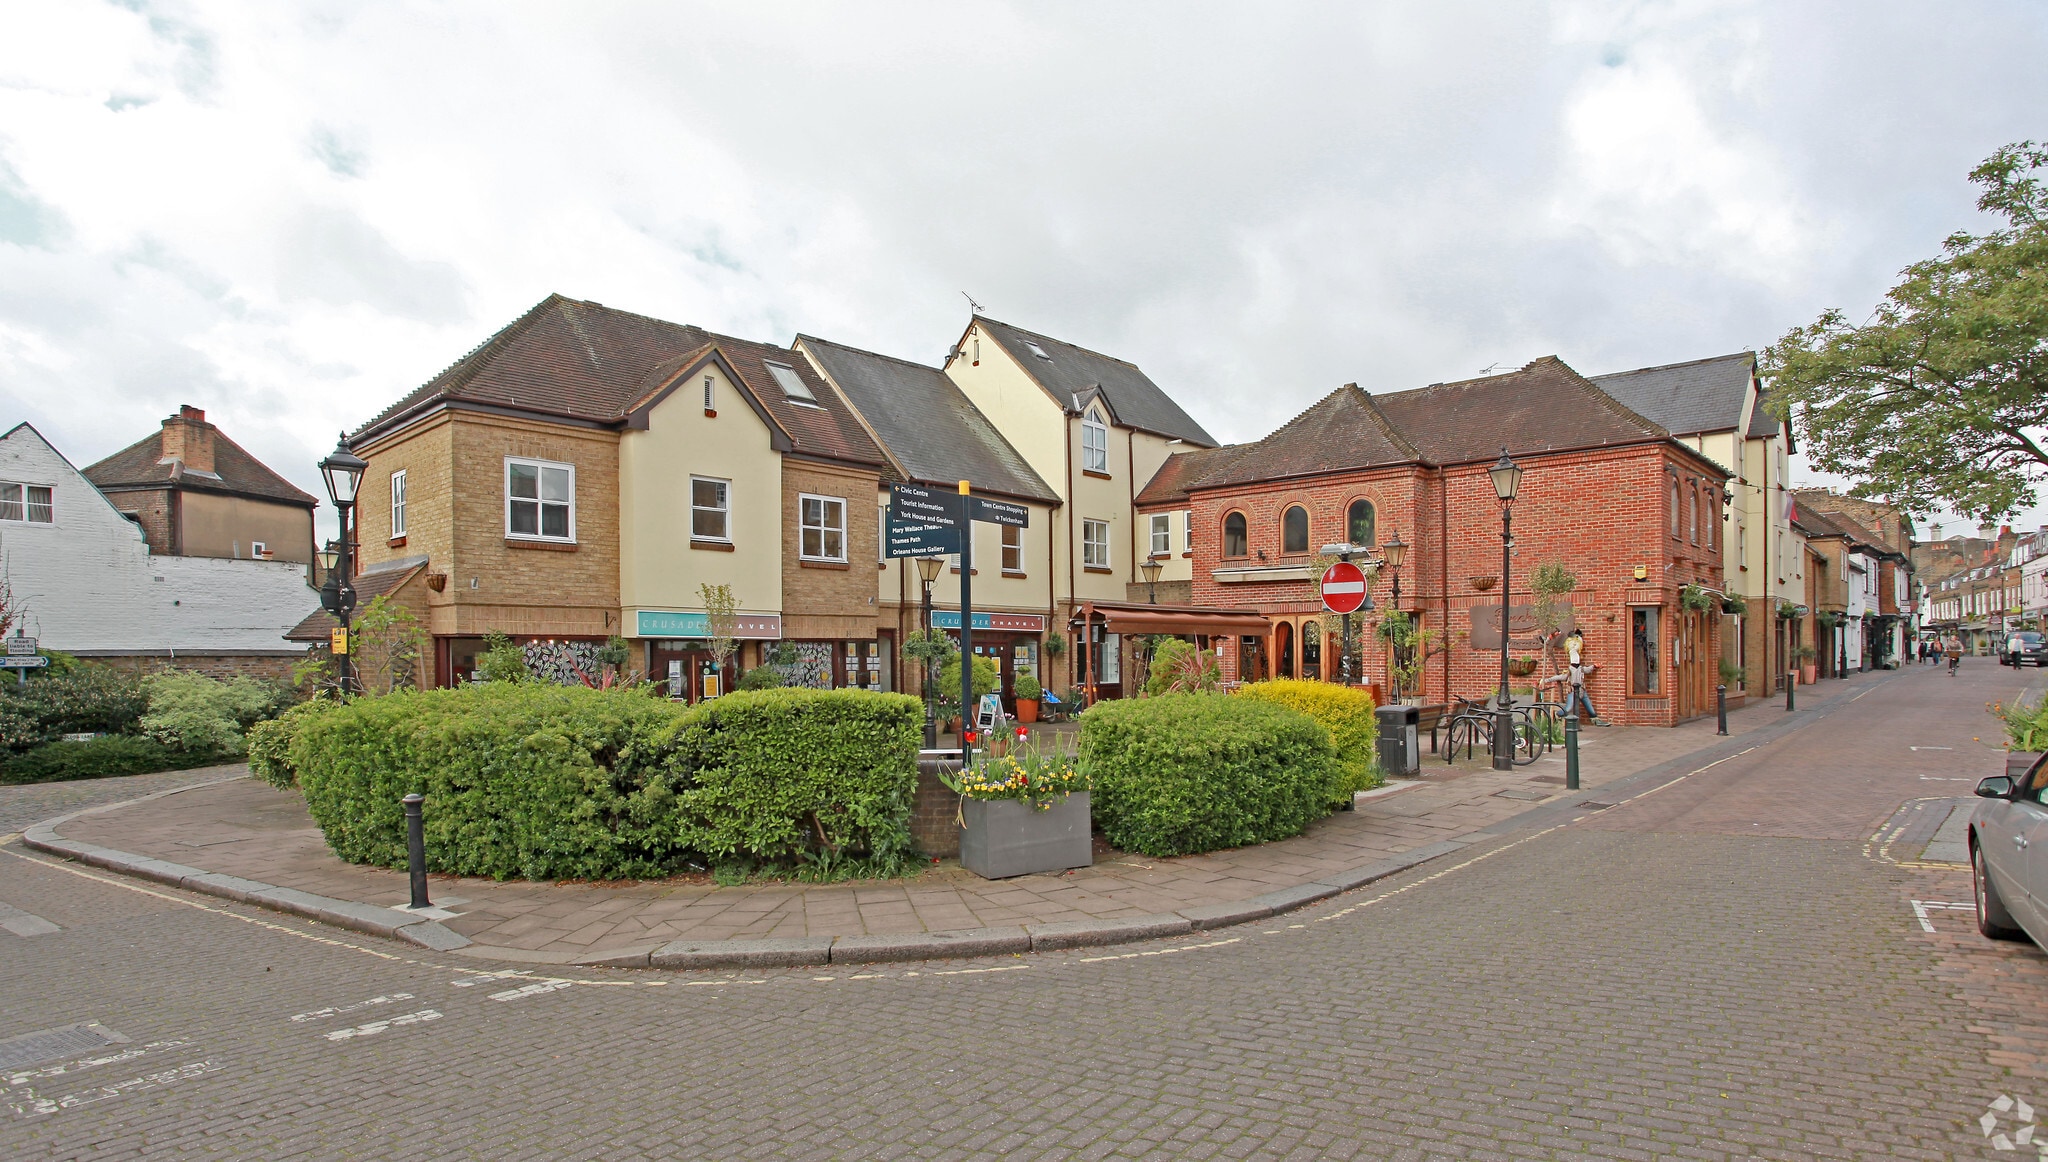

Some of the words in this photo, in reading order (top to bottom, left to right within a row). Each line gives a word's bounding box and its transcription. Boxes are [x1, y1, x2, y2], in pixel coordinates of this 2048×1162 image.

[900, 486, 913, 495] Civic
[912, 489, 929, 498] Centre
[900, 498, 918, 508] Tourist
[918, 502, 944, 512] Information
[992, 503, 1006, 511] Centre
[1006, 505, 1024, 515] Shopping
[912, 512, 926, 520] House
[936, 516, 954, 524] Gardens
[1000, 516, 1024, 524] Twickenham
[642, 619, 712, 630] CRUSADE
